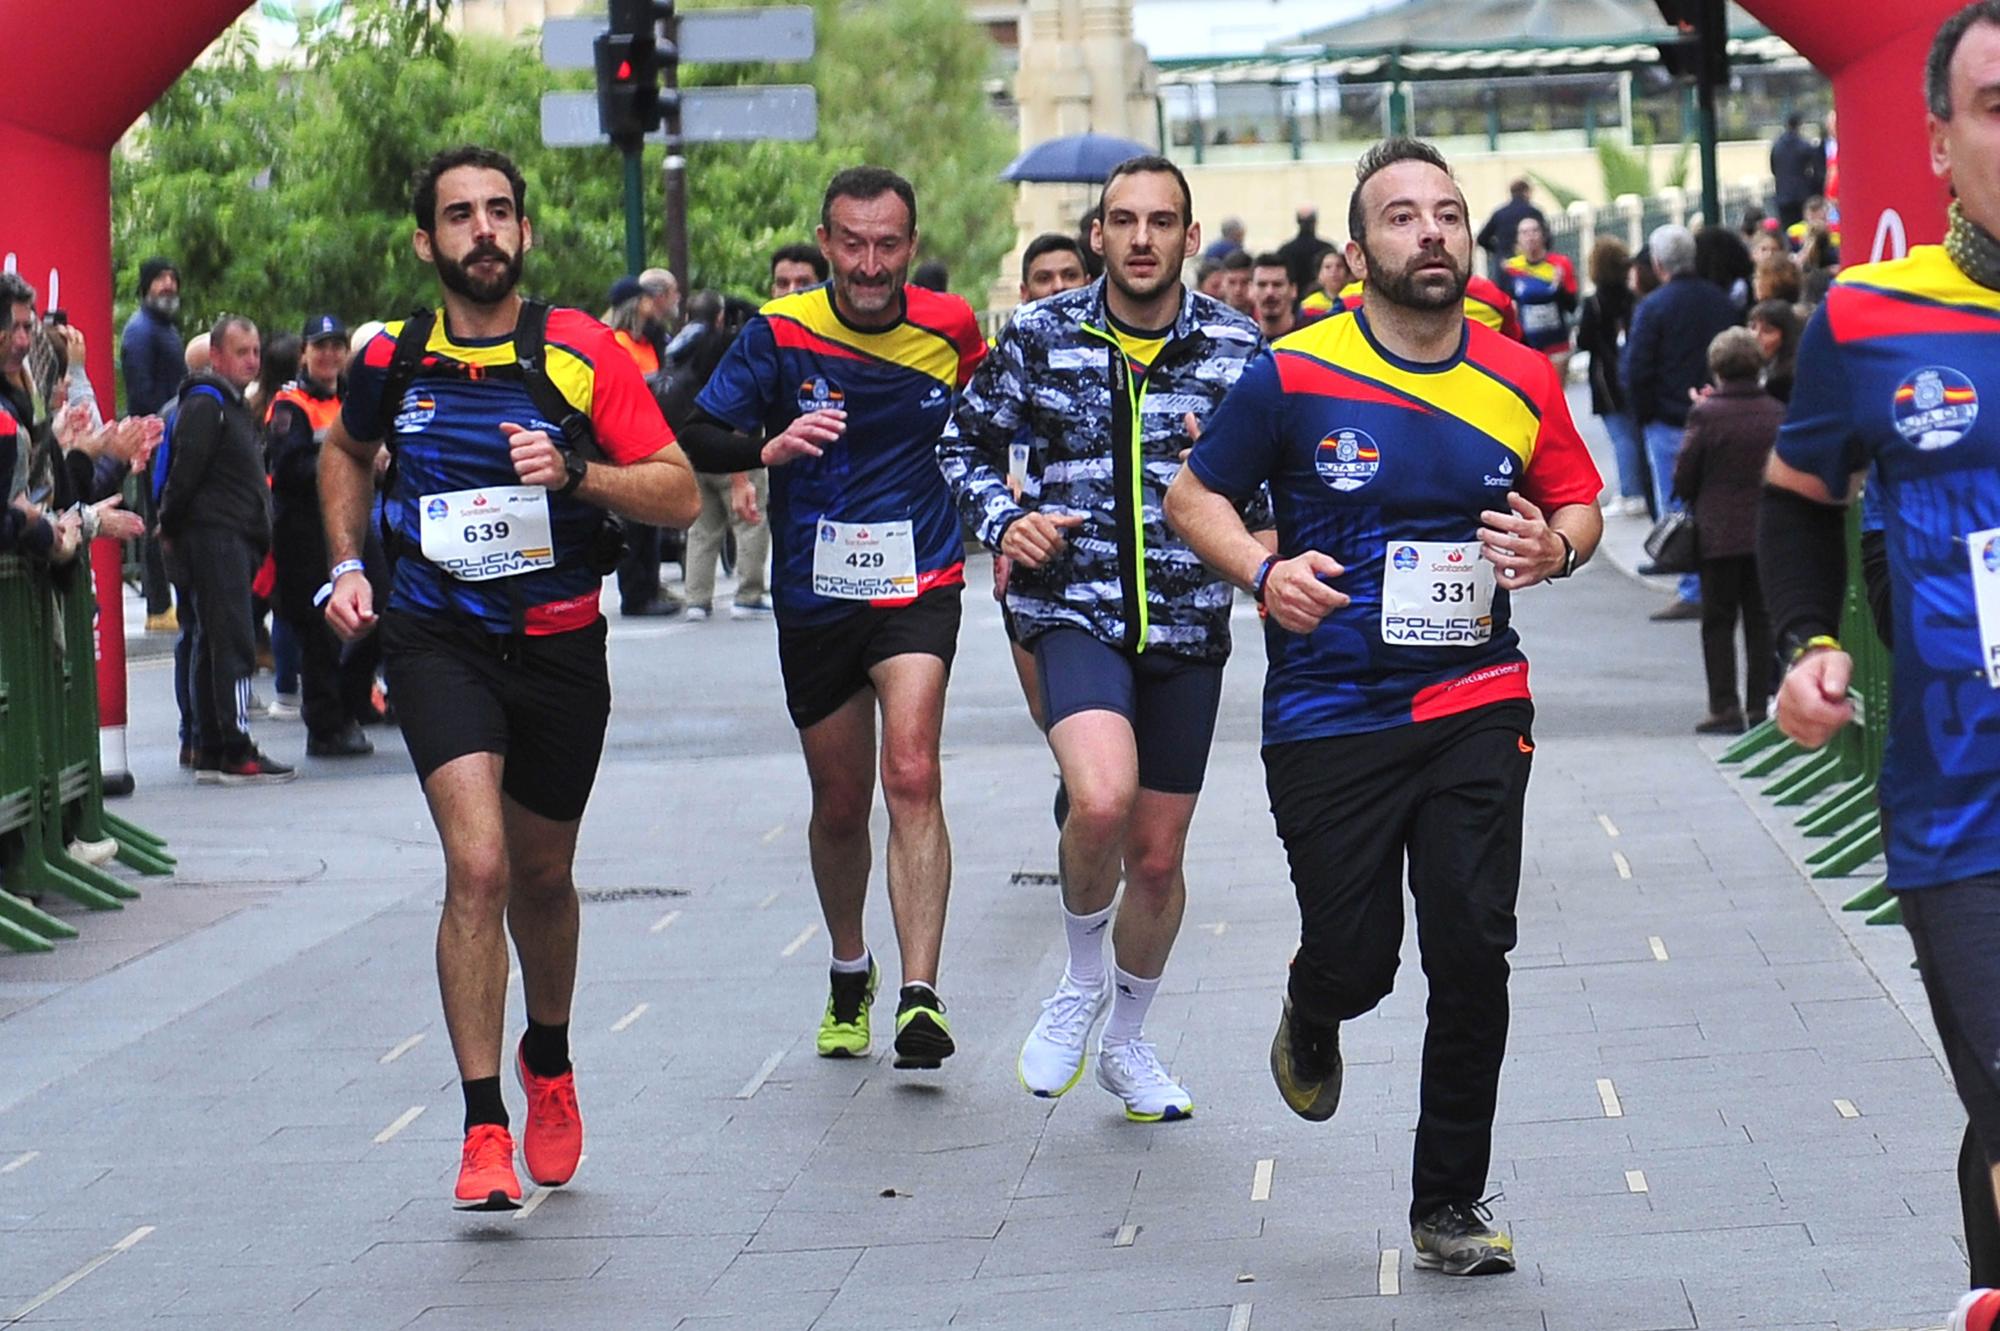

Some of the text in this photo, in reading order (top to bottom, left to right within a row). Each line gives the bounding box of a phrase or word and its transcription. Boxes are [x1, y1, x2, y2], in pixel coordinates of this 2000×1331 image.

[460, 506, 501, 517] Santander
[463, 521, 510, 543] 639
[845, 552, 884, 568] 429
[815, 574, 893, 587] POLICIA
[815, 584, 915, 596] NACIONAL
[1431, 582, 1475, 603] 331
